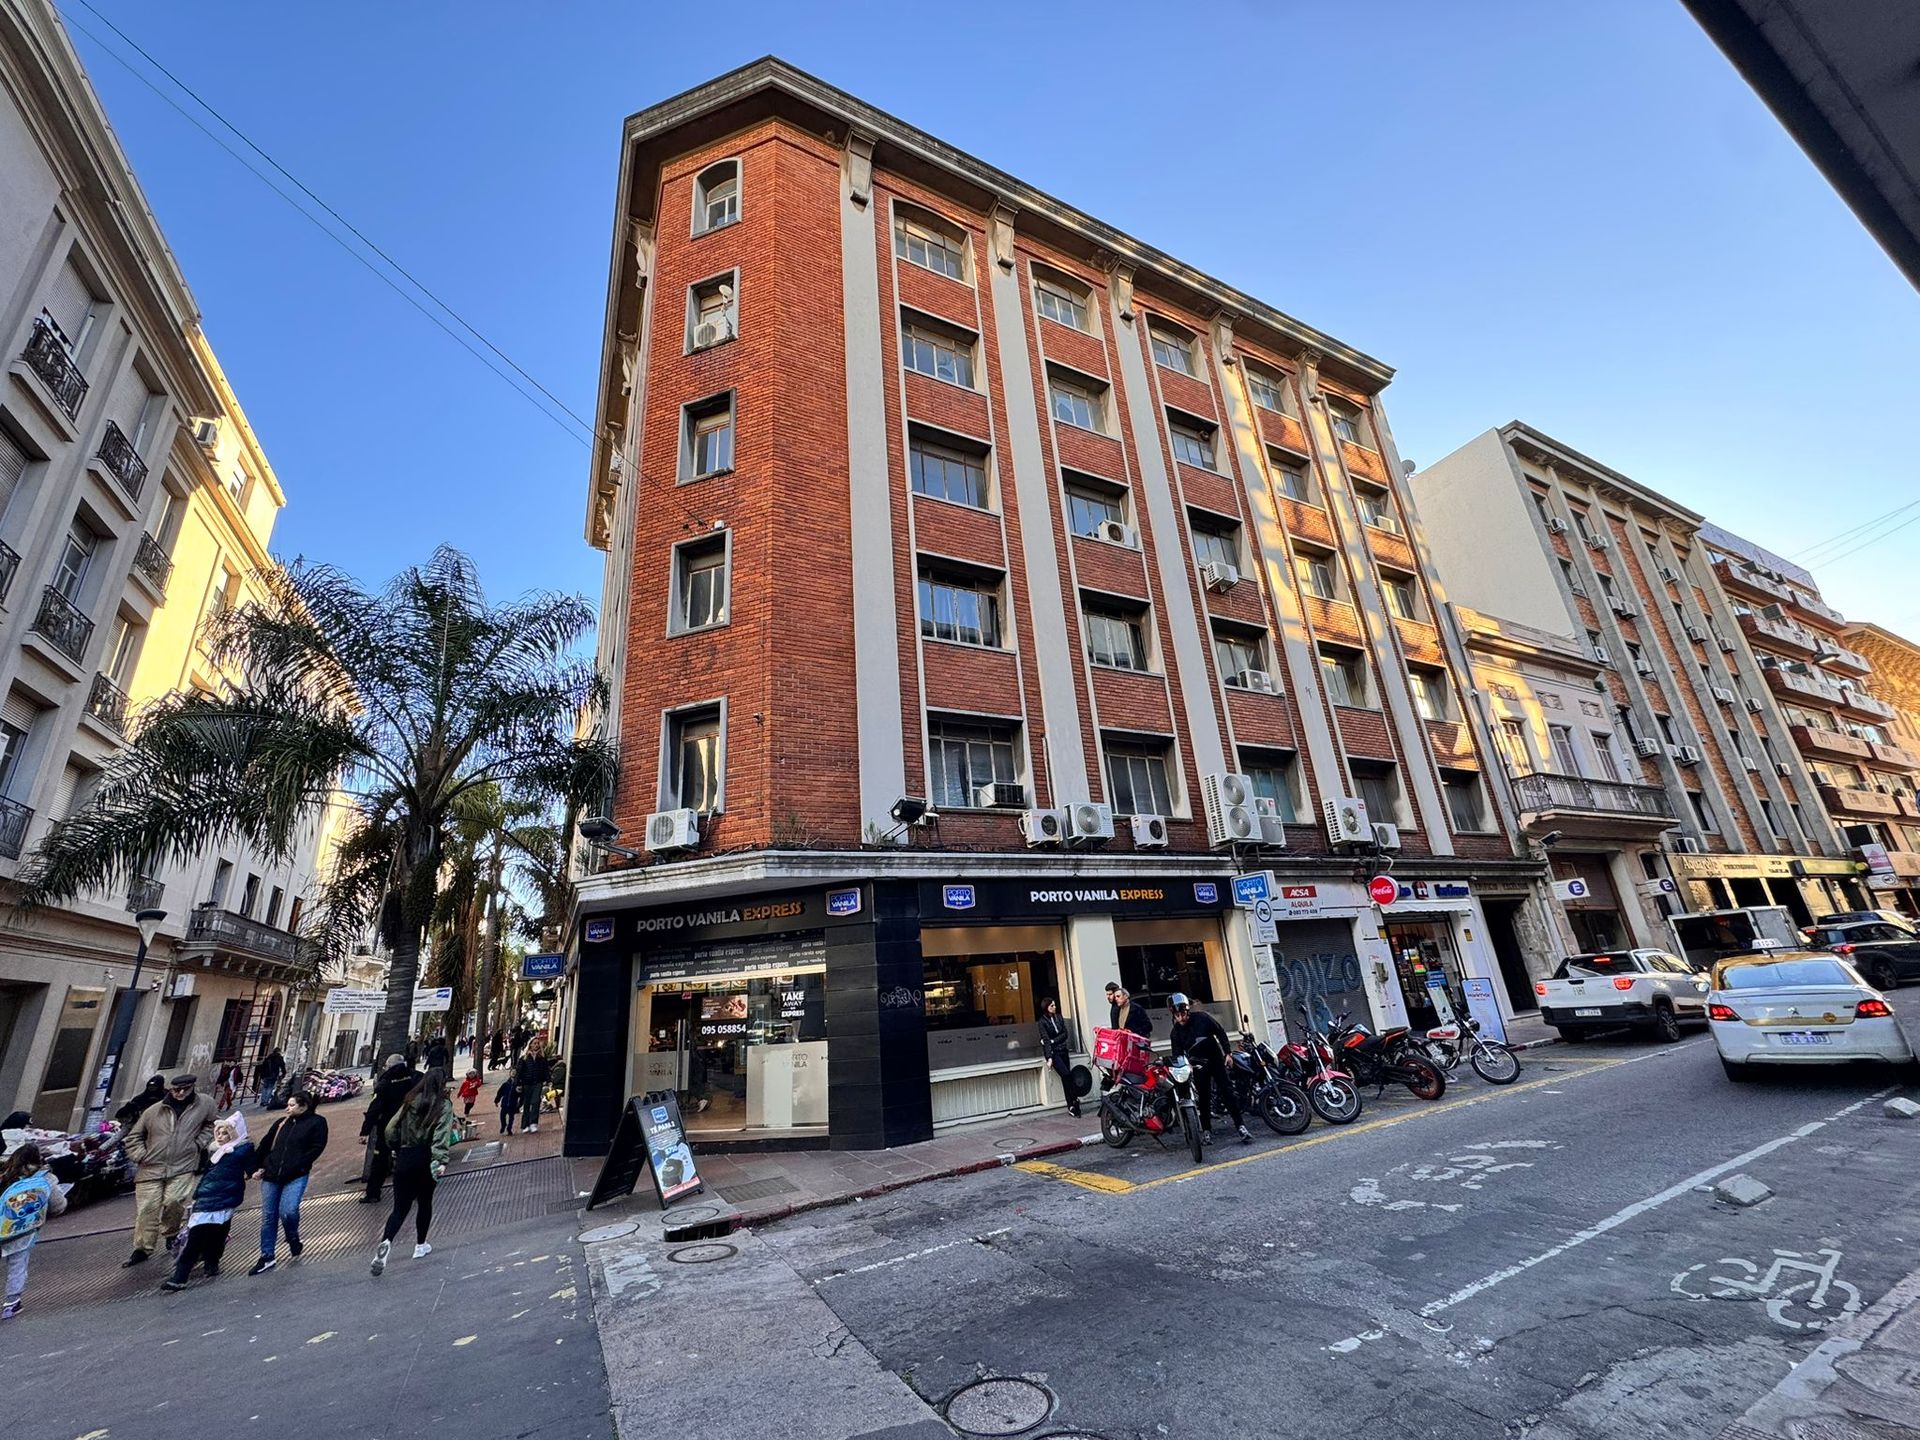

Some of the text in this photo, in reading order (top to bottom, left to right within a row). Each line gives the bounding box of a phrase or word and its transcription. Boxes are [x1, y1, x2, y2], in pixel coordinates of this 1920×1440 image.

[1237, 878, 1263, 888] PORTO
[1663, 881, 1672, 890] E
[1239, 886, 1264, 896] VANILA
[1289, 888, 1310, 897] ACSA
[1572, 883, 1583, 894] E
[831, 893, 856, 901] PORTO
[1030, 889, 1164, 902] PORTO VANILA EXPRESS
[831, 899, 856, 908] VANILA
[636, 902, 802, 932] PORTO VANILA EXPRESS
[590, 927, 610, 935] VANILA
[781, 991, 805, 1001] TAKE
[781, 1009, 805, 1018] EXPRESS
[701, 1024, 747, 1035] 095 058854
